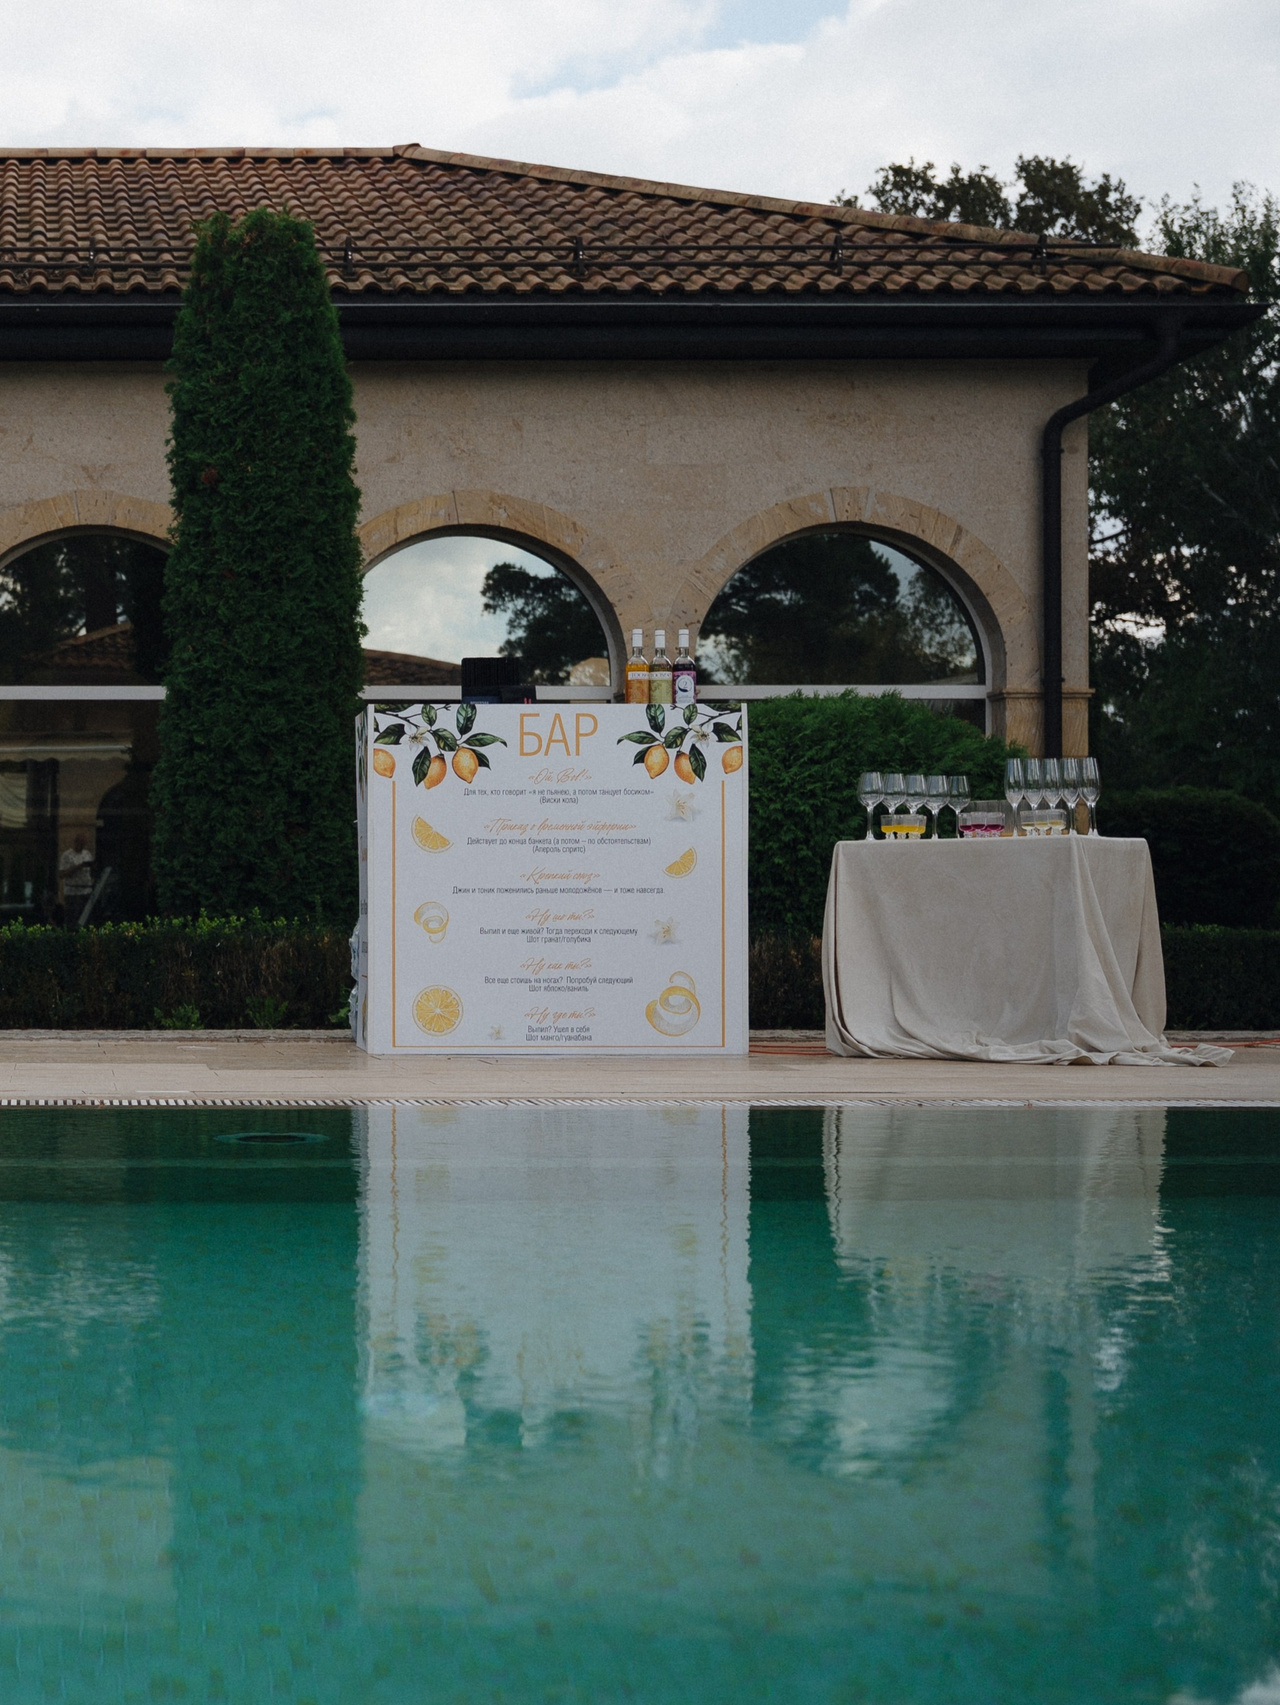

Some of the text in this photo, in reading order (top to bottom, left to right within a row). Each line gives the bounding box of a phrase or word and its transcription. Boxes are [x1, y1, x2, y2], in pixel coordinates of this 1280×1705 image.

[519, 712, 598, 757] БАР
[464, 787, 476, 796] Для
[478, 789, 489, 797] тех,
[502, 789, 527, 797] говорит
[546, 789, 571, 797] пьянею,
[599, 789, 622, 798] танцует
[539, 795, 579, 805] (Виски кола)
[483, 817, 529, 836] «Приказ
[536, 817, 586, 836] временной
[467, 837, 498, 847] Действует
[499, 838, 507, 846] до
[508, 838, 527, 846] конца
[528, 837, 551, 845] банкета
[553, 836, 560, 846] (а
[597, 836, 652, 846] обстоятельствам)
[532, 845, 586, 855] (Апероль спритс)
[520, 865, 573, 885] «Крепкий
[453, 886, 470, 894] Джин
[535, 887, 559, 895] раньше
[560, 886, 603, 895] молодожёнов
[525, 907, 551, 927] «Ну
[479, 927, 500, 935] Выпил
[507, 928, 520, 936] еще
[521, 927, 544, 935] живой?
[546, 927, 563, 936] Тогда
[564, 928, 592, 936] переходи
[599, 928, 638, 937] следующему
[527, 935, 592, 944] Шот гранат/голубика
[520, 957, 545, 976] «Ну
[546, 962, 562, 970] как
[484, 976, 496, 984] Все
[497, 977, 509, 985] еще
[543, 976, 563, 984] ногах?
[566, 976, 597, 985] Попробуй
[598, 976, 634, 986] следующий
[528, 984, 589, 993] Шот яблоко/ваниль
[524, 1006, 551, 1025] «Ну
[552, 1012, 568, 1024] где
[527, 1025, 552, 1033] Выпил?
[553, 1025, 569, 1033] Ушел
[576, 1025, 590, 1033] себя
[525, 1033, 593, 1043] Шот манго/гуанабана
